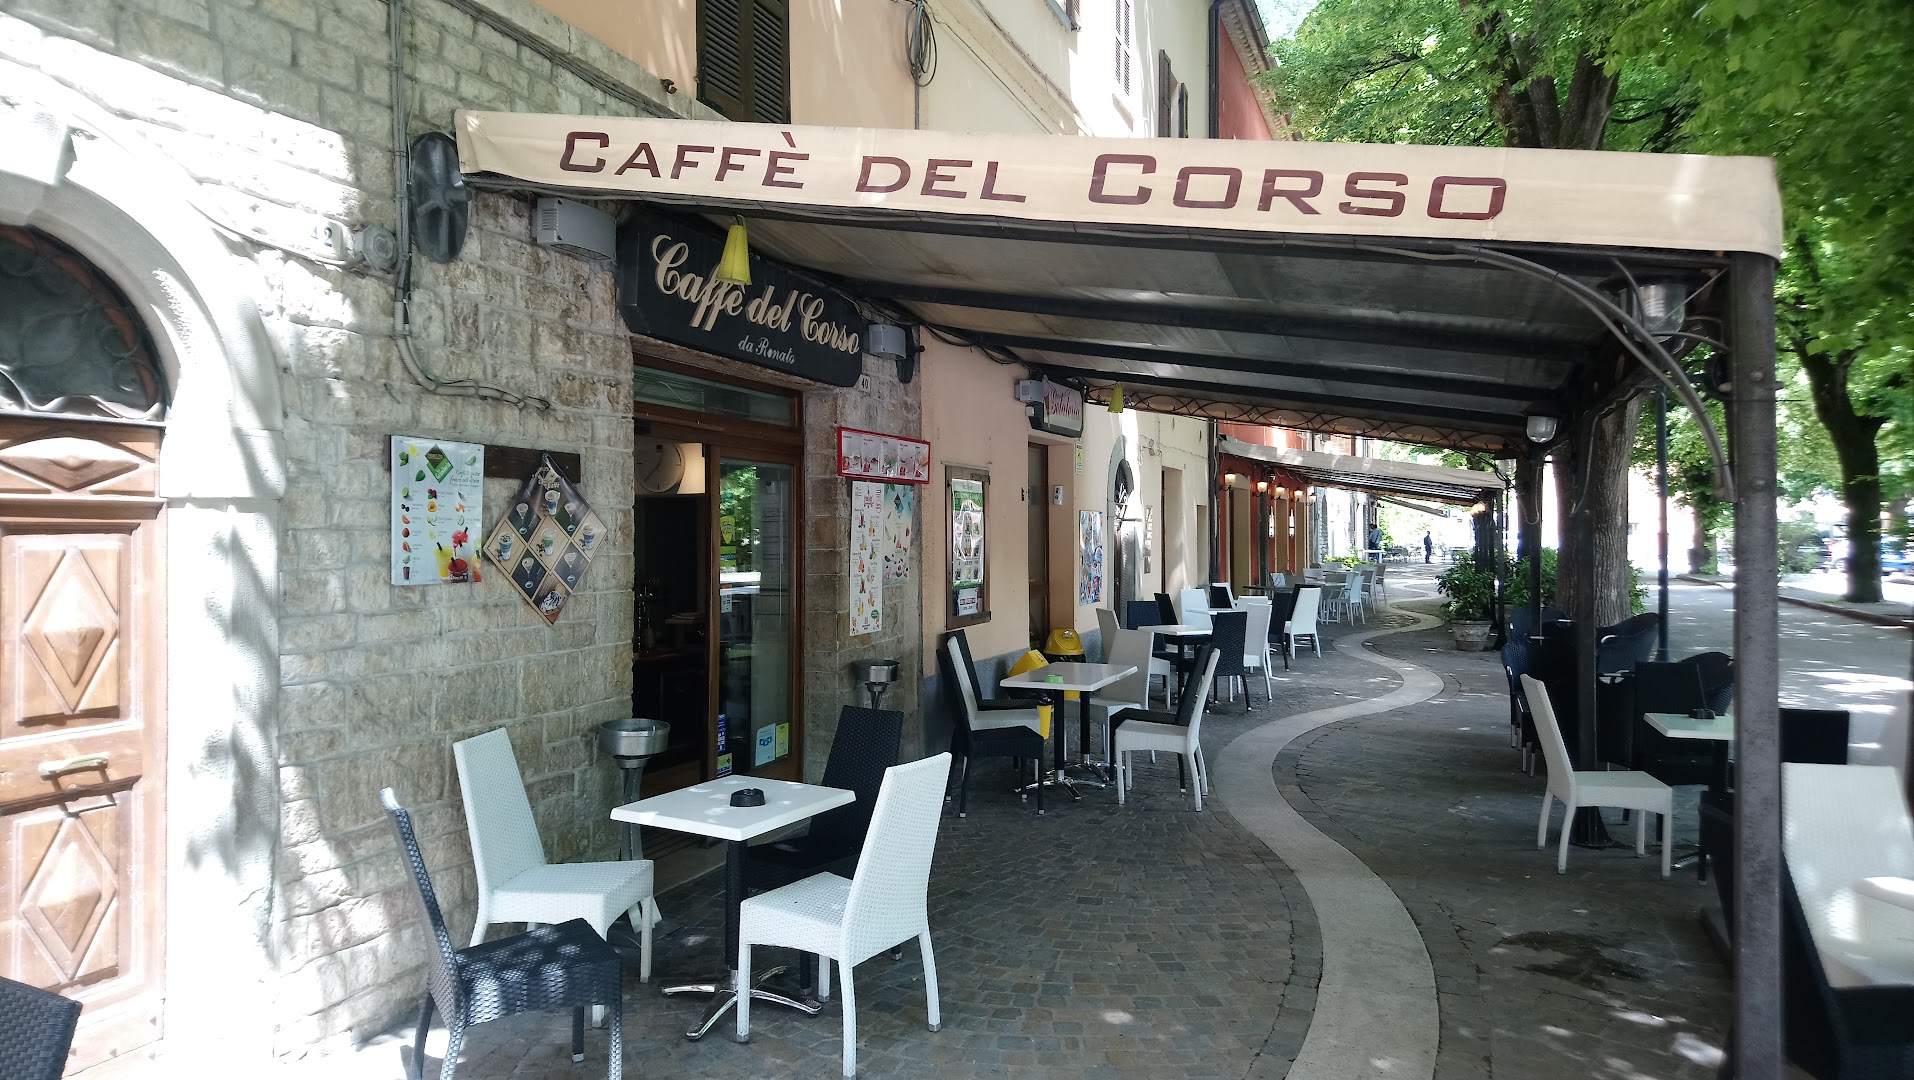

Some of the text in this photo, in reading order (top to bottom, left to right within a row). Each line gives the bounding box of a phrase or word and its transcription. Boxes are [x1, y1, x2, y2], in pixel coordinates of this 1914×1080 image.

[559, 130, 1508, 221] CAFFÈ DEL CORSO
[747, 285, 799, 333] del
[799, 292, 860, 355] Corso
[738, 334, 753, 353] da
[861, 378, 869, 389] 40
